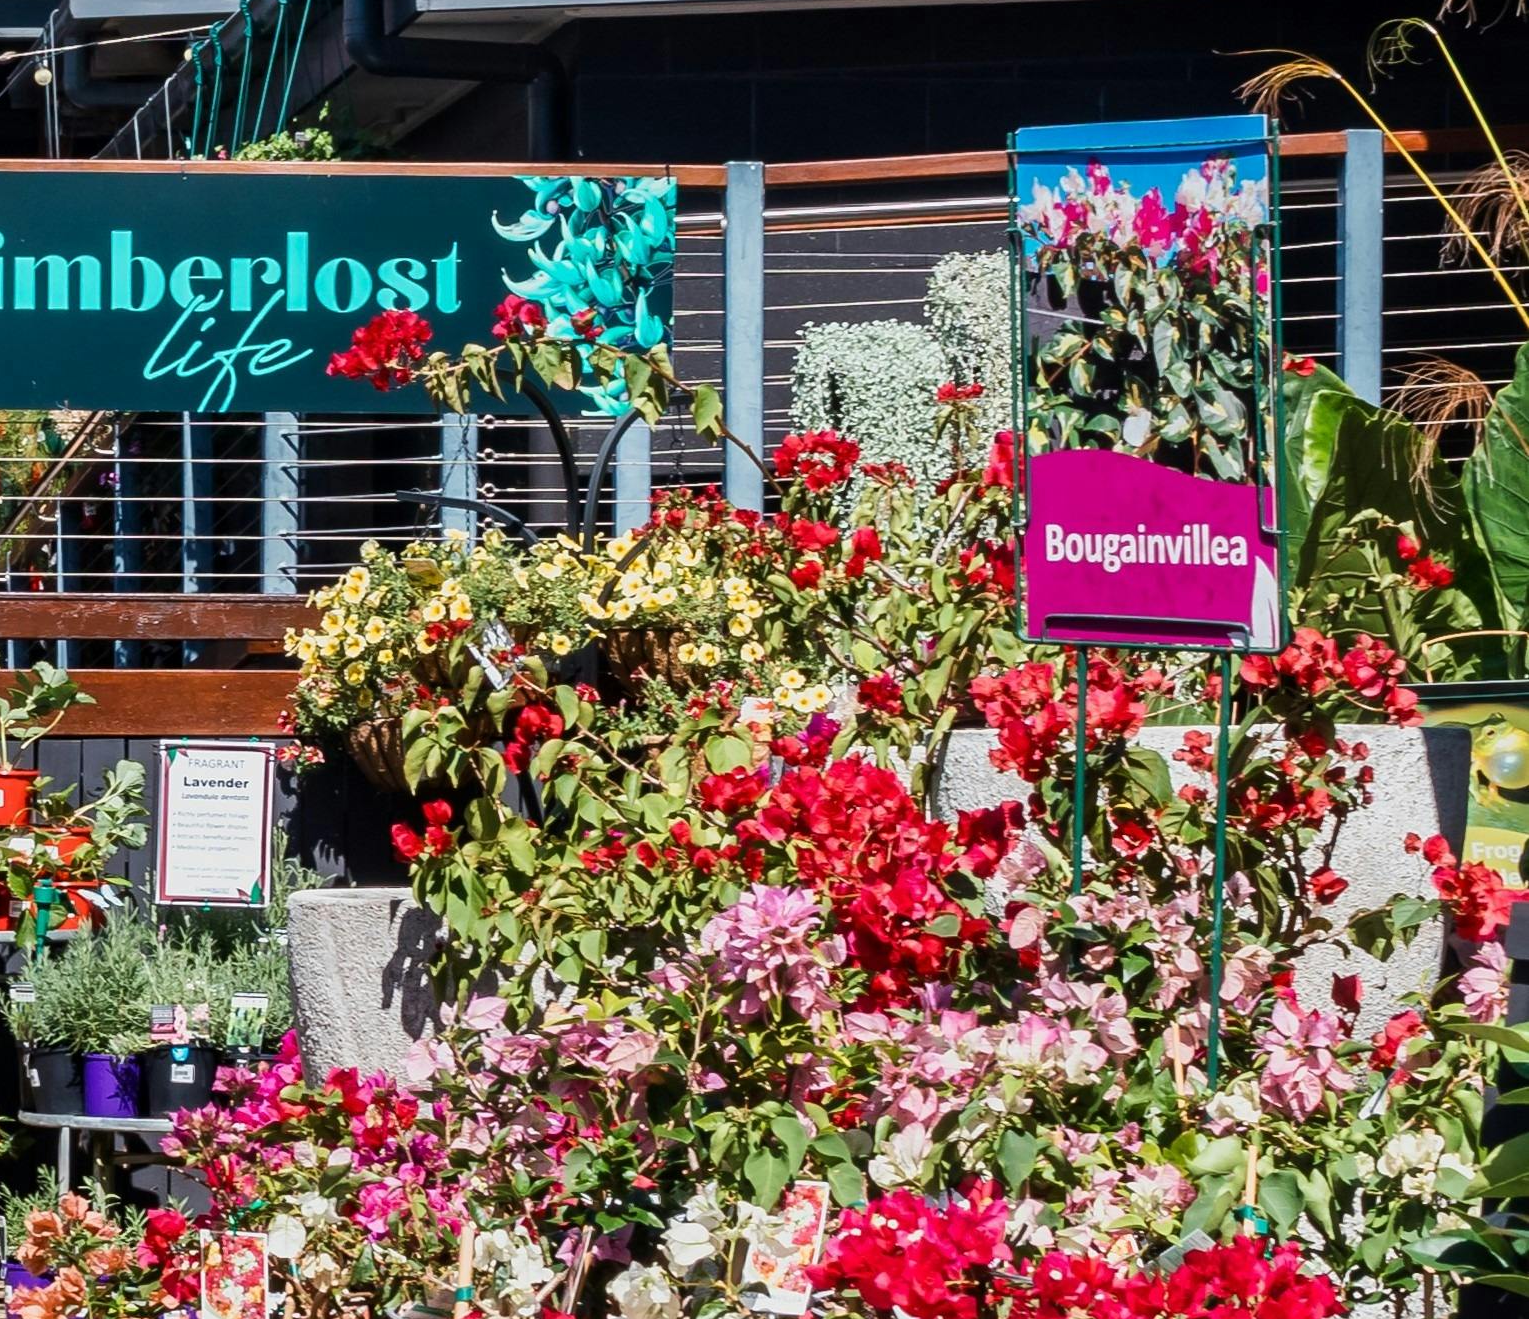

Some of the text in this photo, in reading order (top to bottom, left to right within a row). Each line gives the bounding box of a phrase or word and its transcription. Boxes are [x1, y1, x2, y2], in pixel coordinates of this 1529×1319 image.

[143, 288, 314, 413] life
[1045, 523, 1249, 573] Bougainvillea
[188, 759, 246, 769] FRAGRANT
[184, 776, 250, 789] Lavender
